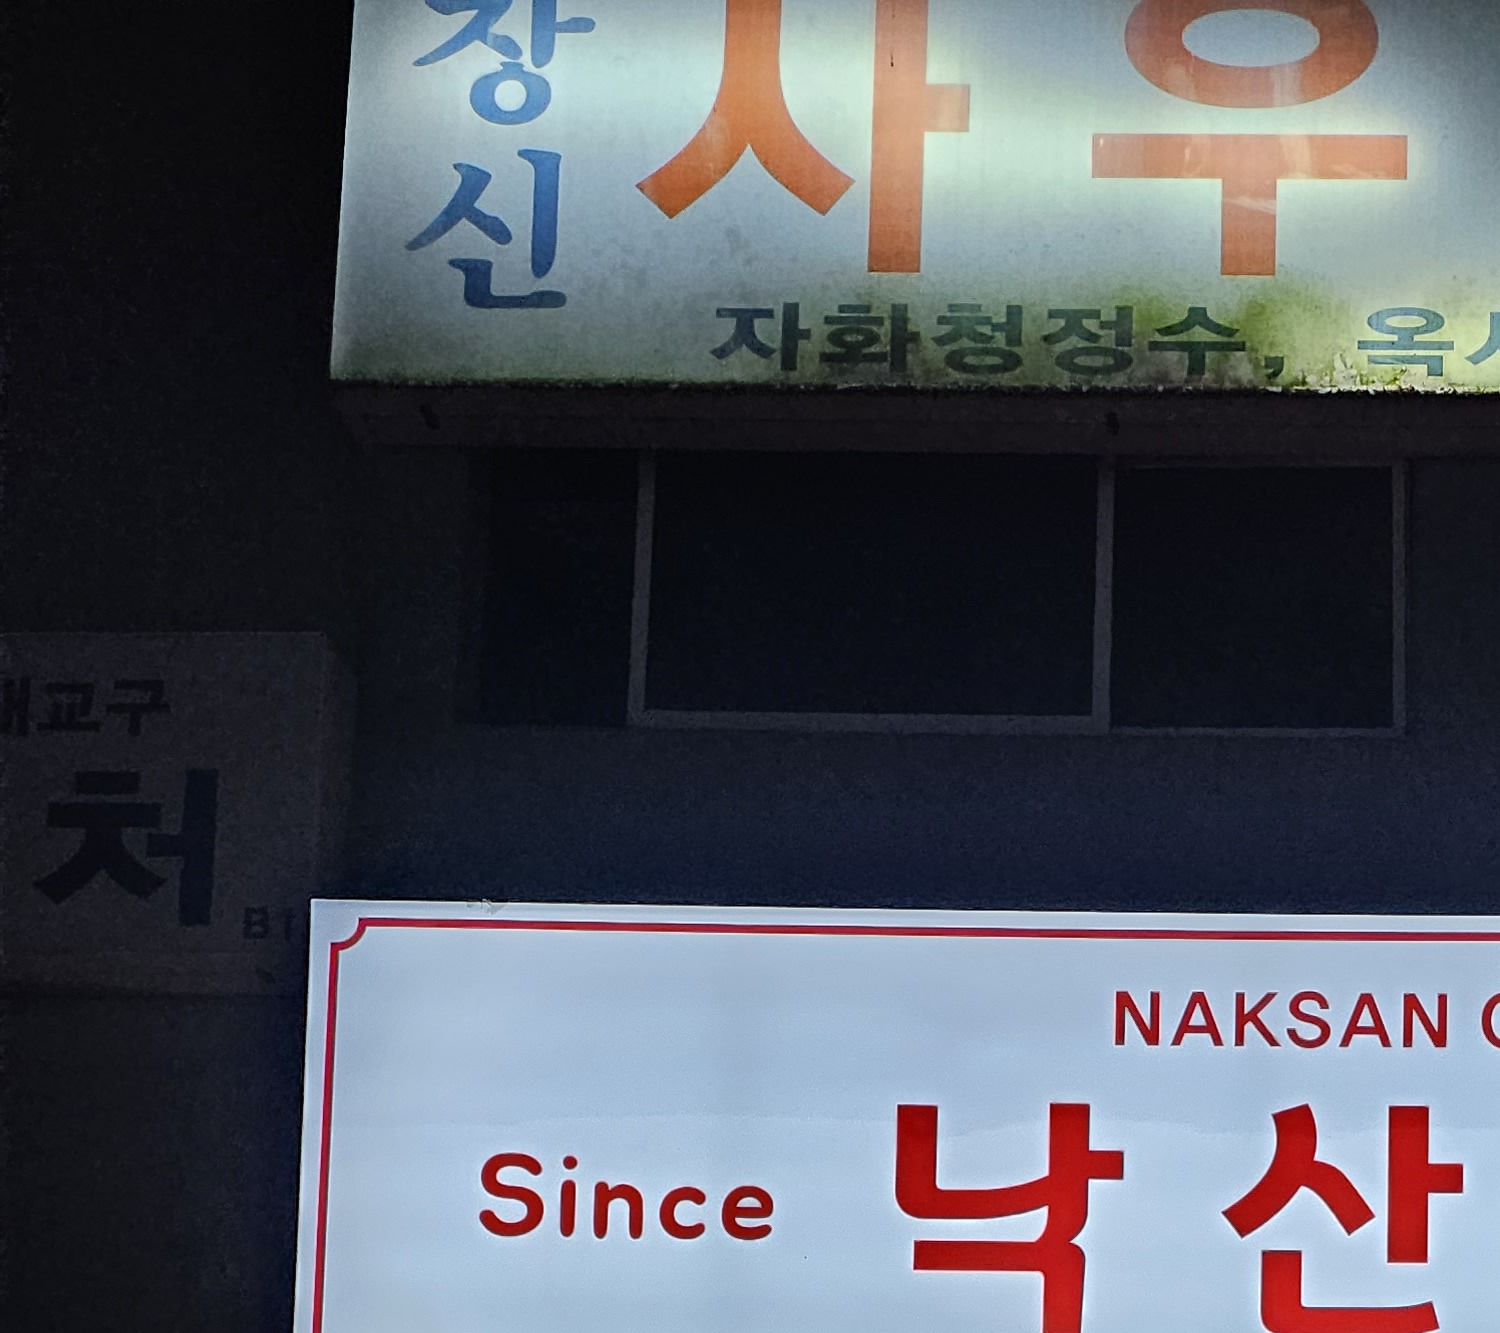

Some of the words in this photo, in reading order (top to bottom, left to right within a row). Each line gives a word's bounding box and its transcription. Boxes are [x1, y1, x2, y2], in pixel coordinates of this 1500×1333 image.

[709, 303, 1284, 380] 자화청정수,
[1115, 991, 1450, 1049] NAKSAN
[479, 1152, 775, 1241] Since
